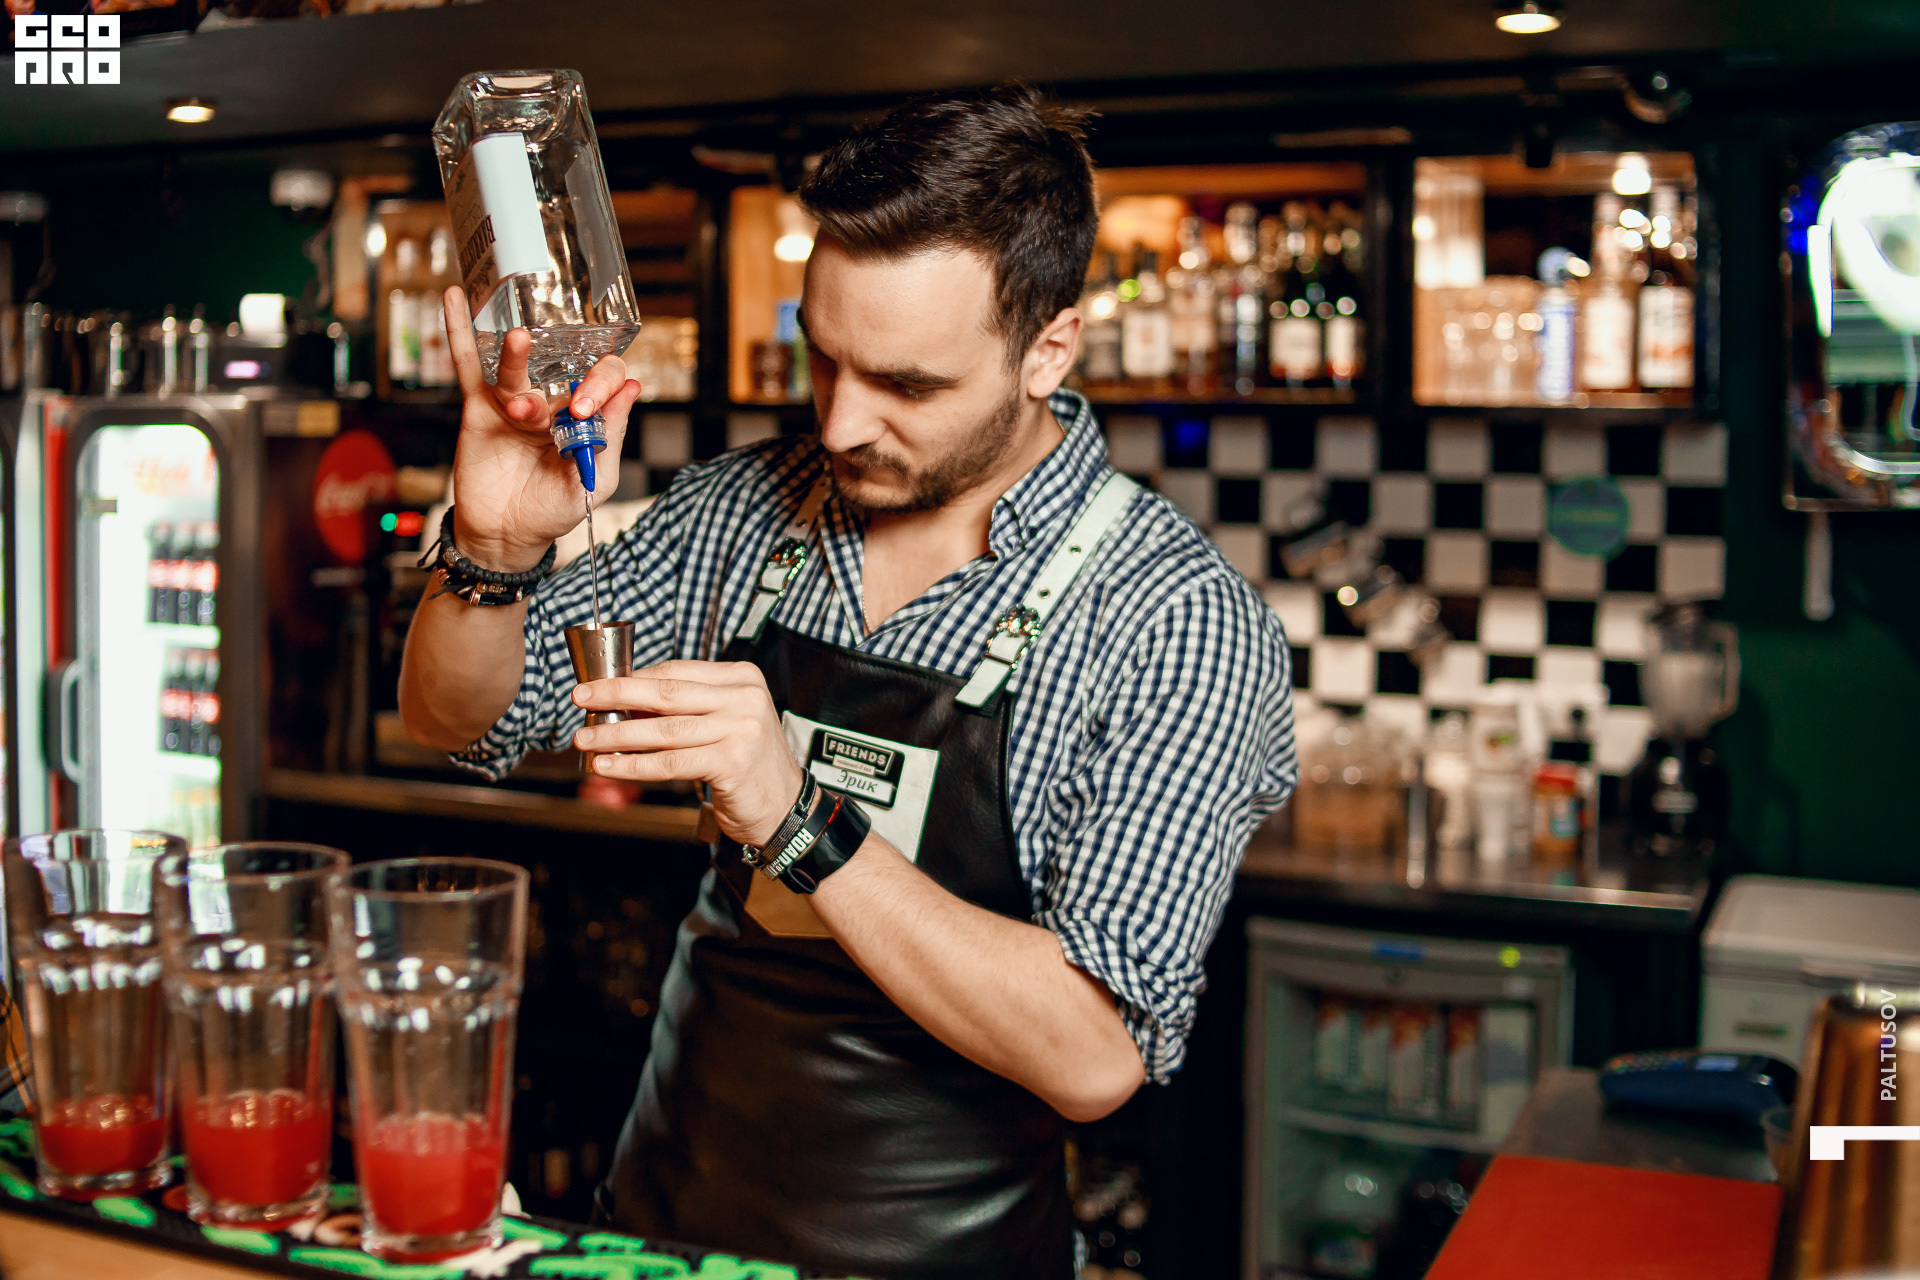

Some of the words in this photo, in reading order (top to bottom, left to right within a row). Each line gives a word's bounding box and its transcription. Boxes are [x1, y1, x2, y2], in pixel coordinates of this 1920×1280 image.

[828, 739, 887, 767] FRIENDS
[837, 769, 878, 793] Эрик
[777, 827, 815, 866] ROAD
